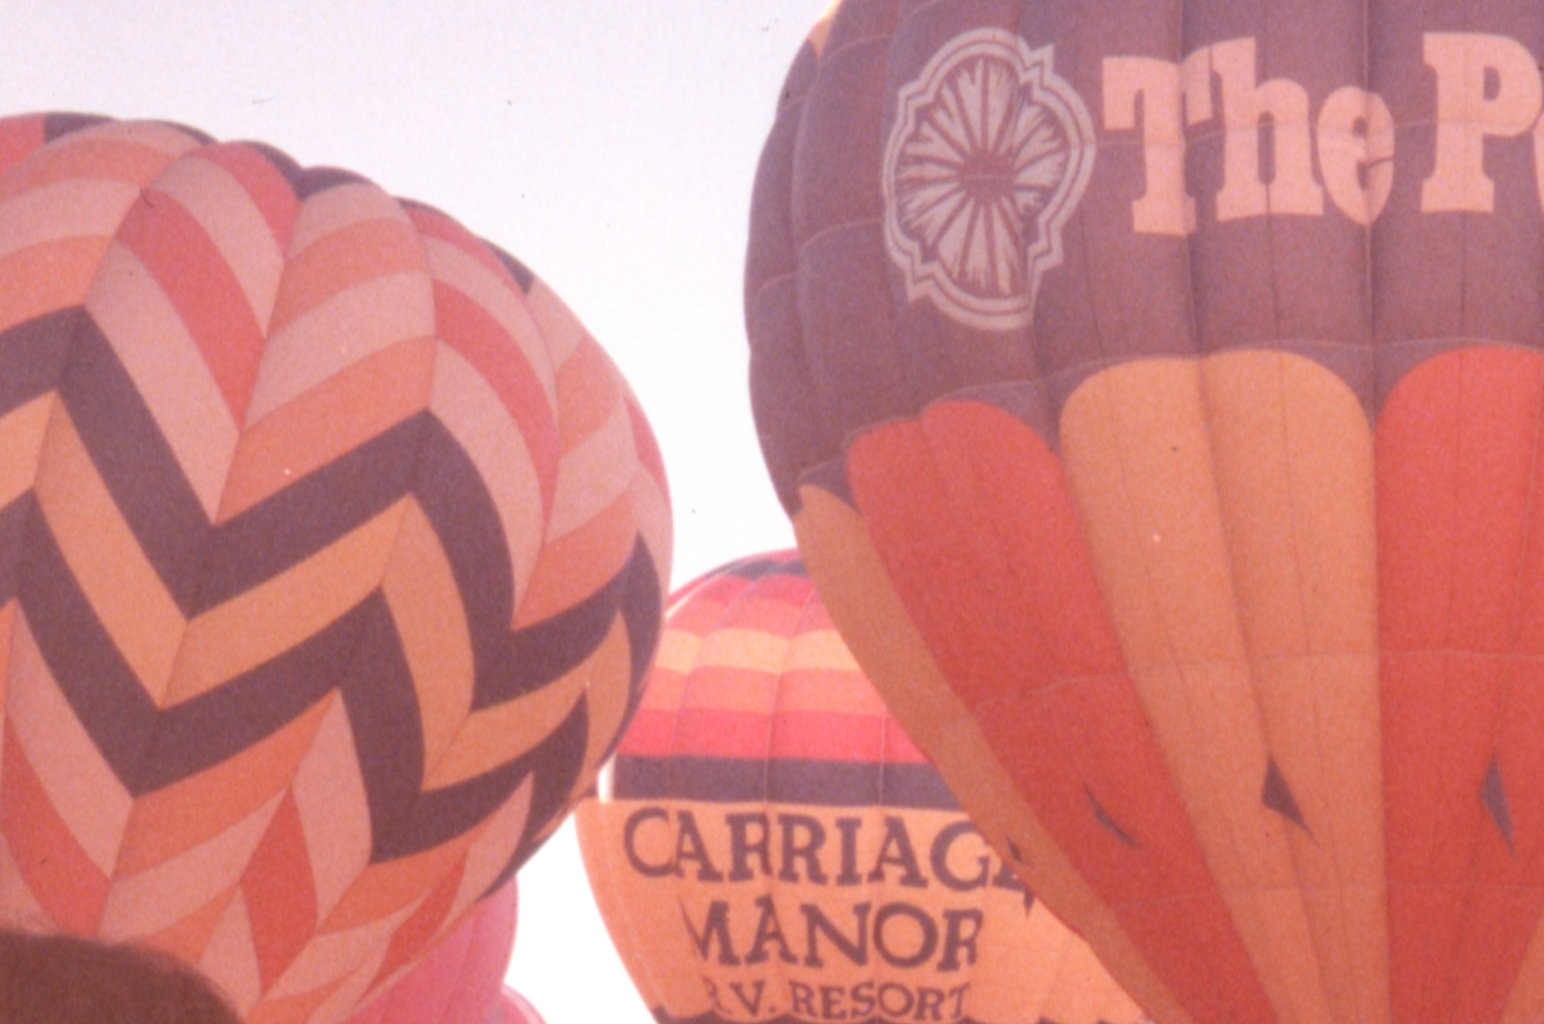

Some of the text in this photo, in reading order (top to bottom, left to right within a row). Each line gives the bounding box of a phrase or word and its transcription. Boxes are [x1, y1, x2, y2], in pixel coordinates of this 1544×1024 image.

[1102, 37, 1394, 235] The
[677, 894, 984, 972] MANOR
[789, 979, 970, 1022] RESORT
